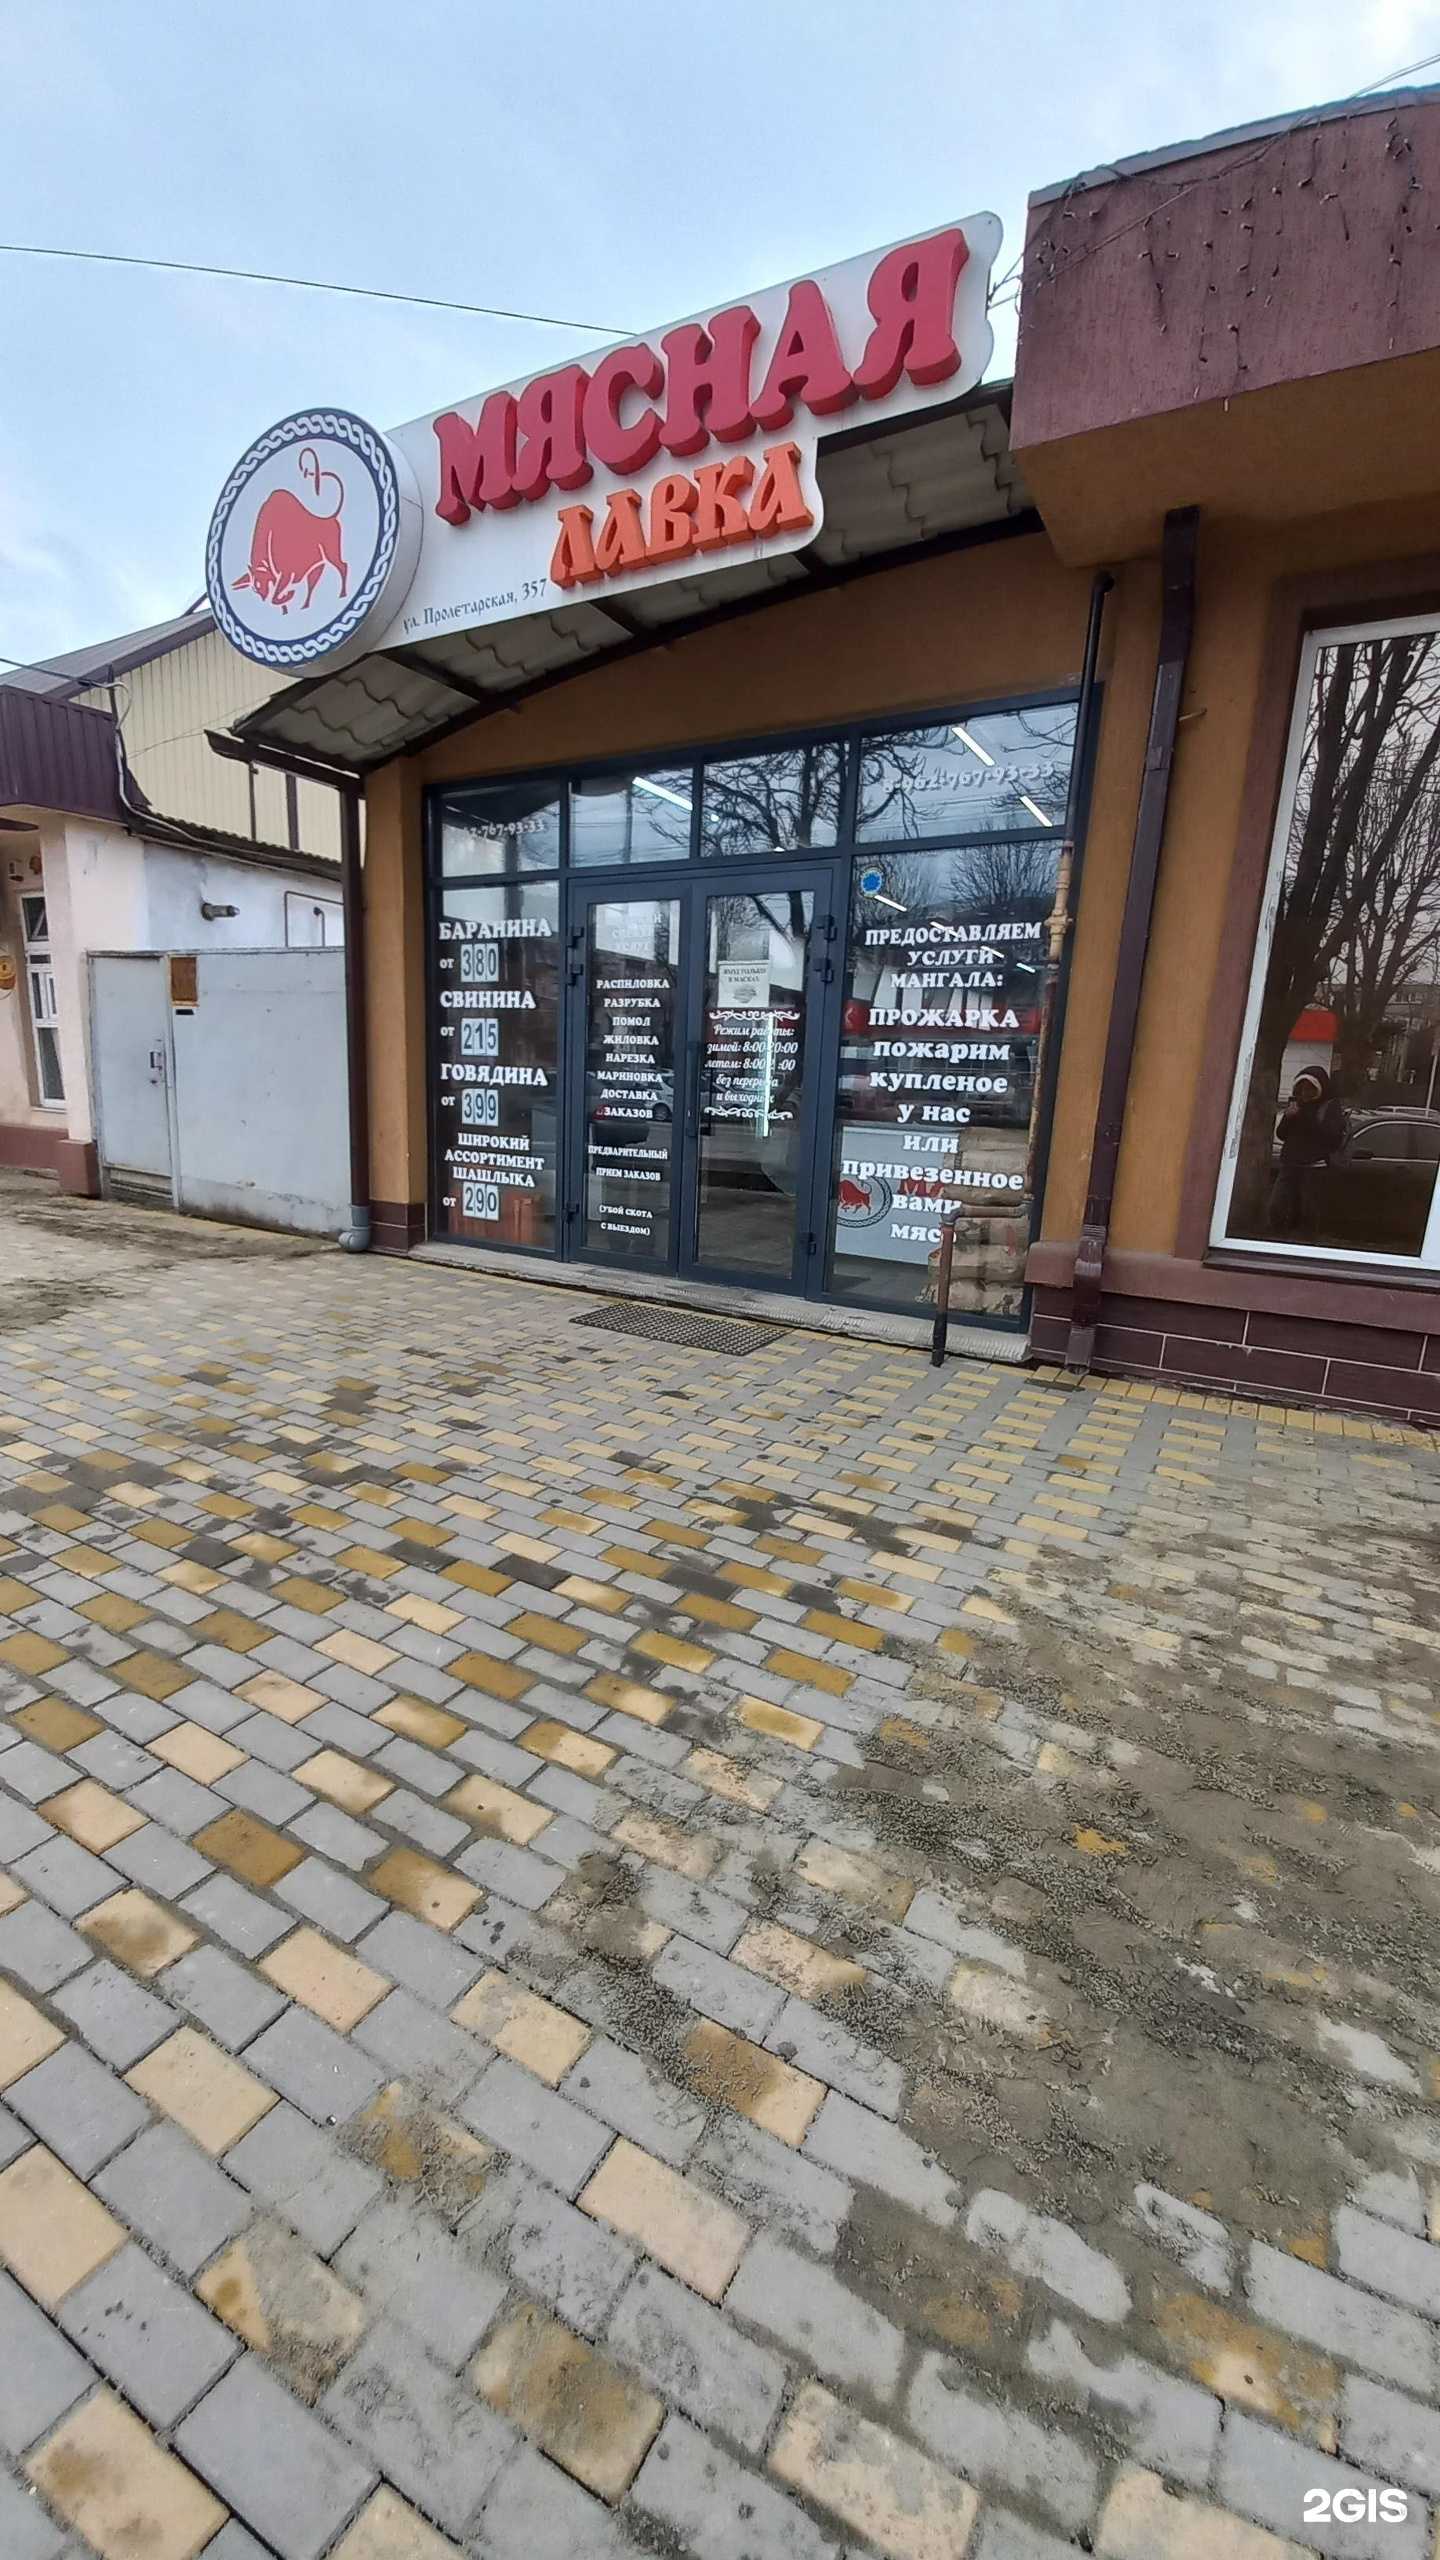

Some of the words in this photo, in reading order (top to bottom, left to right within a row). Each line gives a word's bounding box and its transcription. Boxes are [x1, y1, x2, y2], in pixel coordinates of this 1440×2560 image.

[433, 228, 969, 525] МЯСНАЯ
[550, 441, 814, 588] ЛАВКА
[522, 578, 547, 600] 357
[439, 918, 553, 940] БАРАНИНА
[864, 921, 1042, 946] ПРЕДОСТАВЛЯЕМ
[439, 958, 455, 969] от
[463, 948, 497, 976] 380
[906, 948, 994, 966] УСЛУГИ
[596, 979, 670, 989] РАСПИЛОВКА
[890, 971, 1004, 988] МАНГАЛА:
[440, 990, 537, 1009] СВИНИНА
[604, 998, 661, 1008] РАЗРУБКА
[612, 1017, 651, 1026] ПОМОЛ
[868, 1007, 1020, 1029] ПРОЖАРКА
[440, 1026, 455, 1037] от
[463, 1022, 497, 1050] 215
[603, 1035, 659, 1045] ЖИЛОВКА
[706, 1042, 742, 1054] зимой:
[873, 1040, 1011, 1063] пожарим
[605, 1053, 655, 1064] НАРЕЗКА
[704, 1060, 742, 1069] летом:
[440, 1063, 548, 1086] ГОВЯДИНА
[597, 1071, 663, 1083] МАРИНОВКА
[716, 1073, 732, 1088] без
[870, 1071, 1008, 1093] купленое
[600, 1089, 658, 1101] ДОСТАВКА
[441, 1096, 455, 1106] от
[464, 1093, 497, 1120] 399
[603, 1106, 653, 1119] ЗАКАЗОВ
[897, 1103, 915, 1123] у
[921, 1105, 971, 1123] нас
[457, 1132, 530, 1151] ШИРОКИЙ
[903, 1134, 960, 1153] или
[444, 1149, 544, 1170] АССОРТИМЕНТ
[588, 1145, 668, 1160] ПРЕДВАРИТЕЛЬНЫЙ
[452, 1166, 535, 1187] ШАШЛЫКА
[596, 1167, 622, 1178] ПРИЕМ
[623, 1170, 661, 1181] ЗАКАЗОВ
[841, 1158, 1024, 1190] привезенное
[442, 1196, 456, 1207] от
[464, 1186, 497, 1212] 290
[625, 1208, 653, 1219] СКОТА
